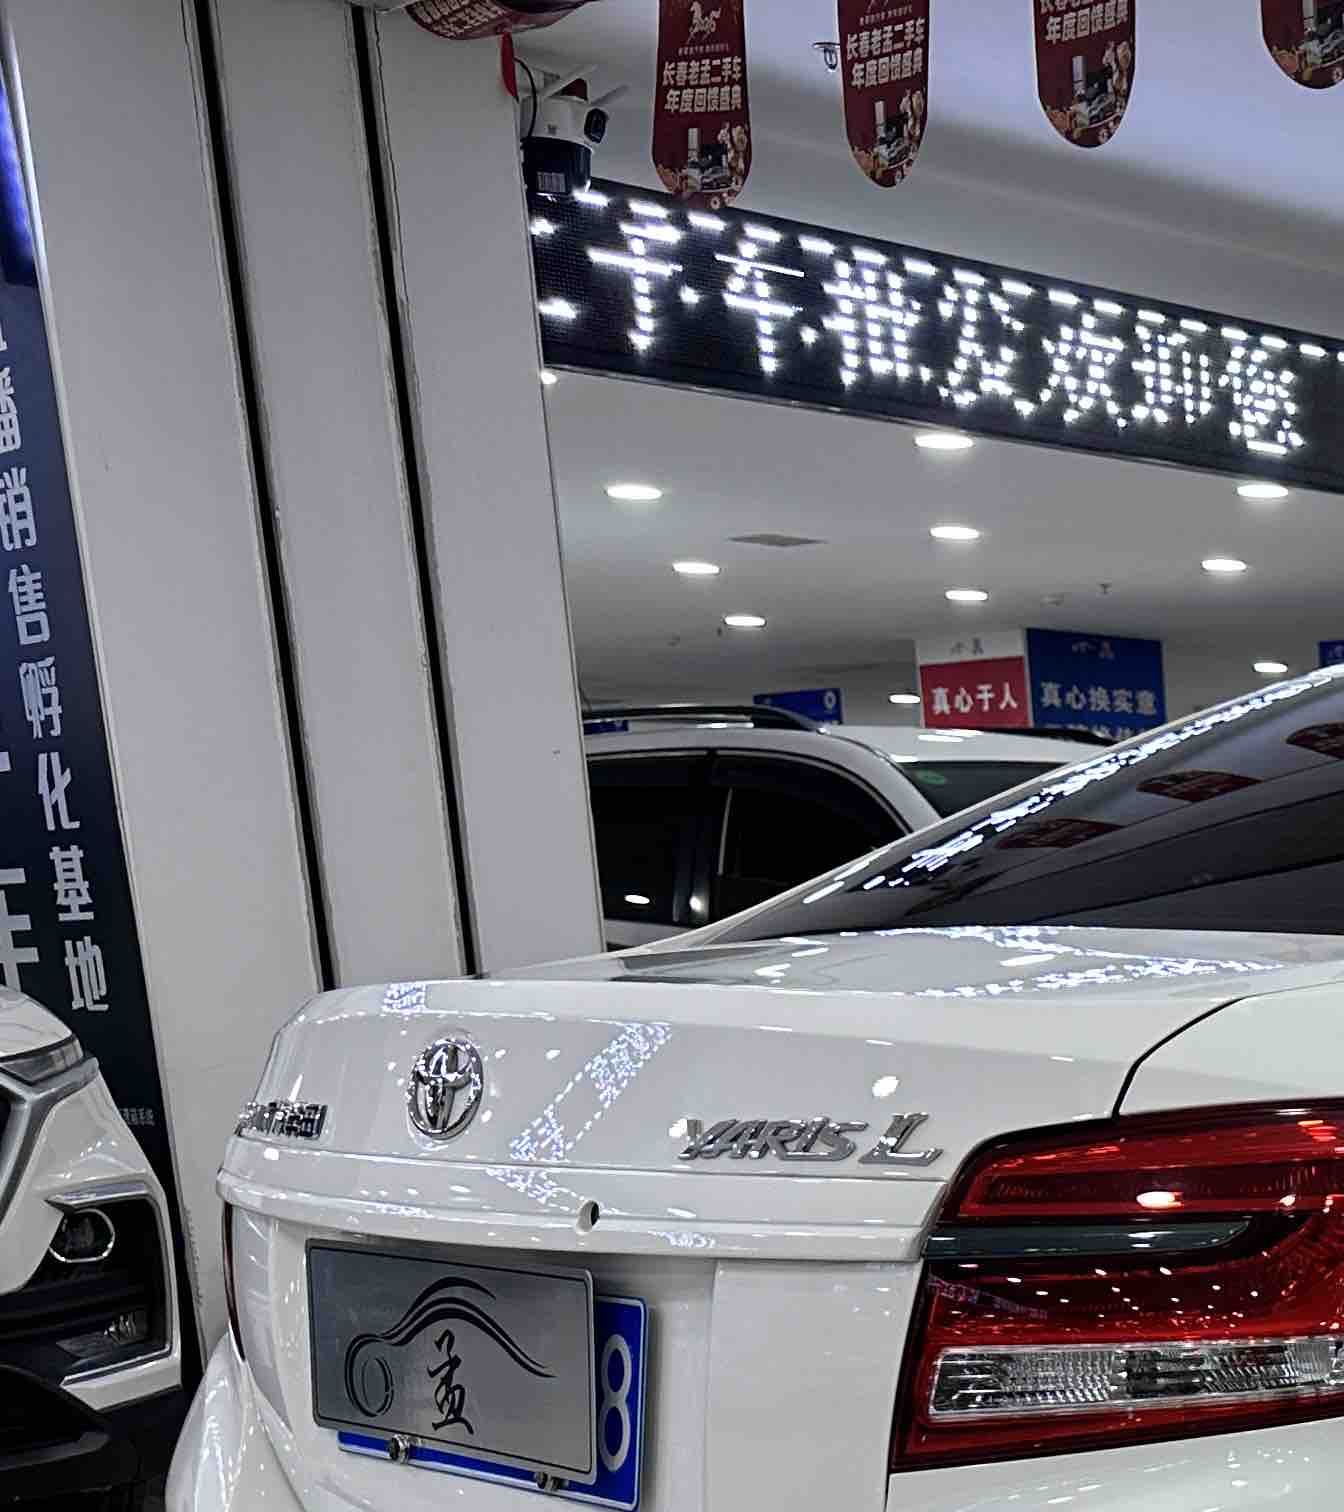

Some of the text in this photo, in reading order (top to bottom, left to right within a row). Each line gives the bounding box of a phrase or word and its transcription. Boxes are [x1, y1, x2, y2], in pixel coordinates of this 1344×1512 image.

[662, 56, 742, 86] 长春老孟二手车
[858, 1112, 944, 1166] L
